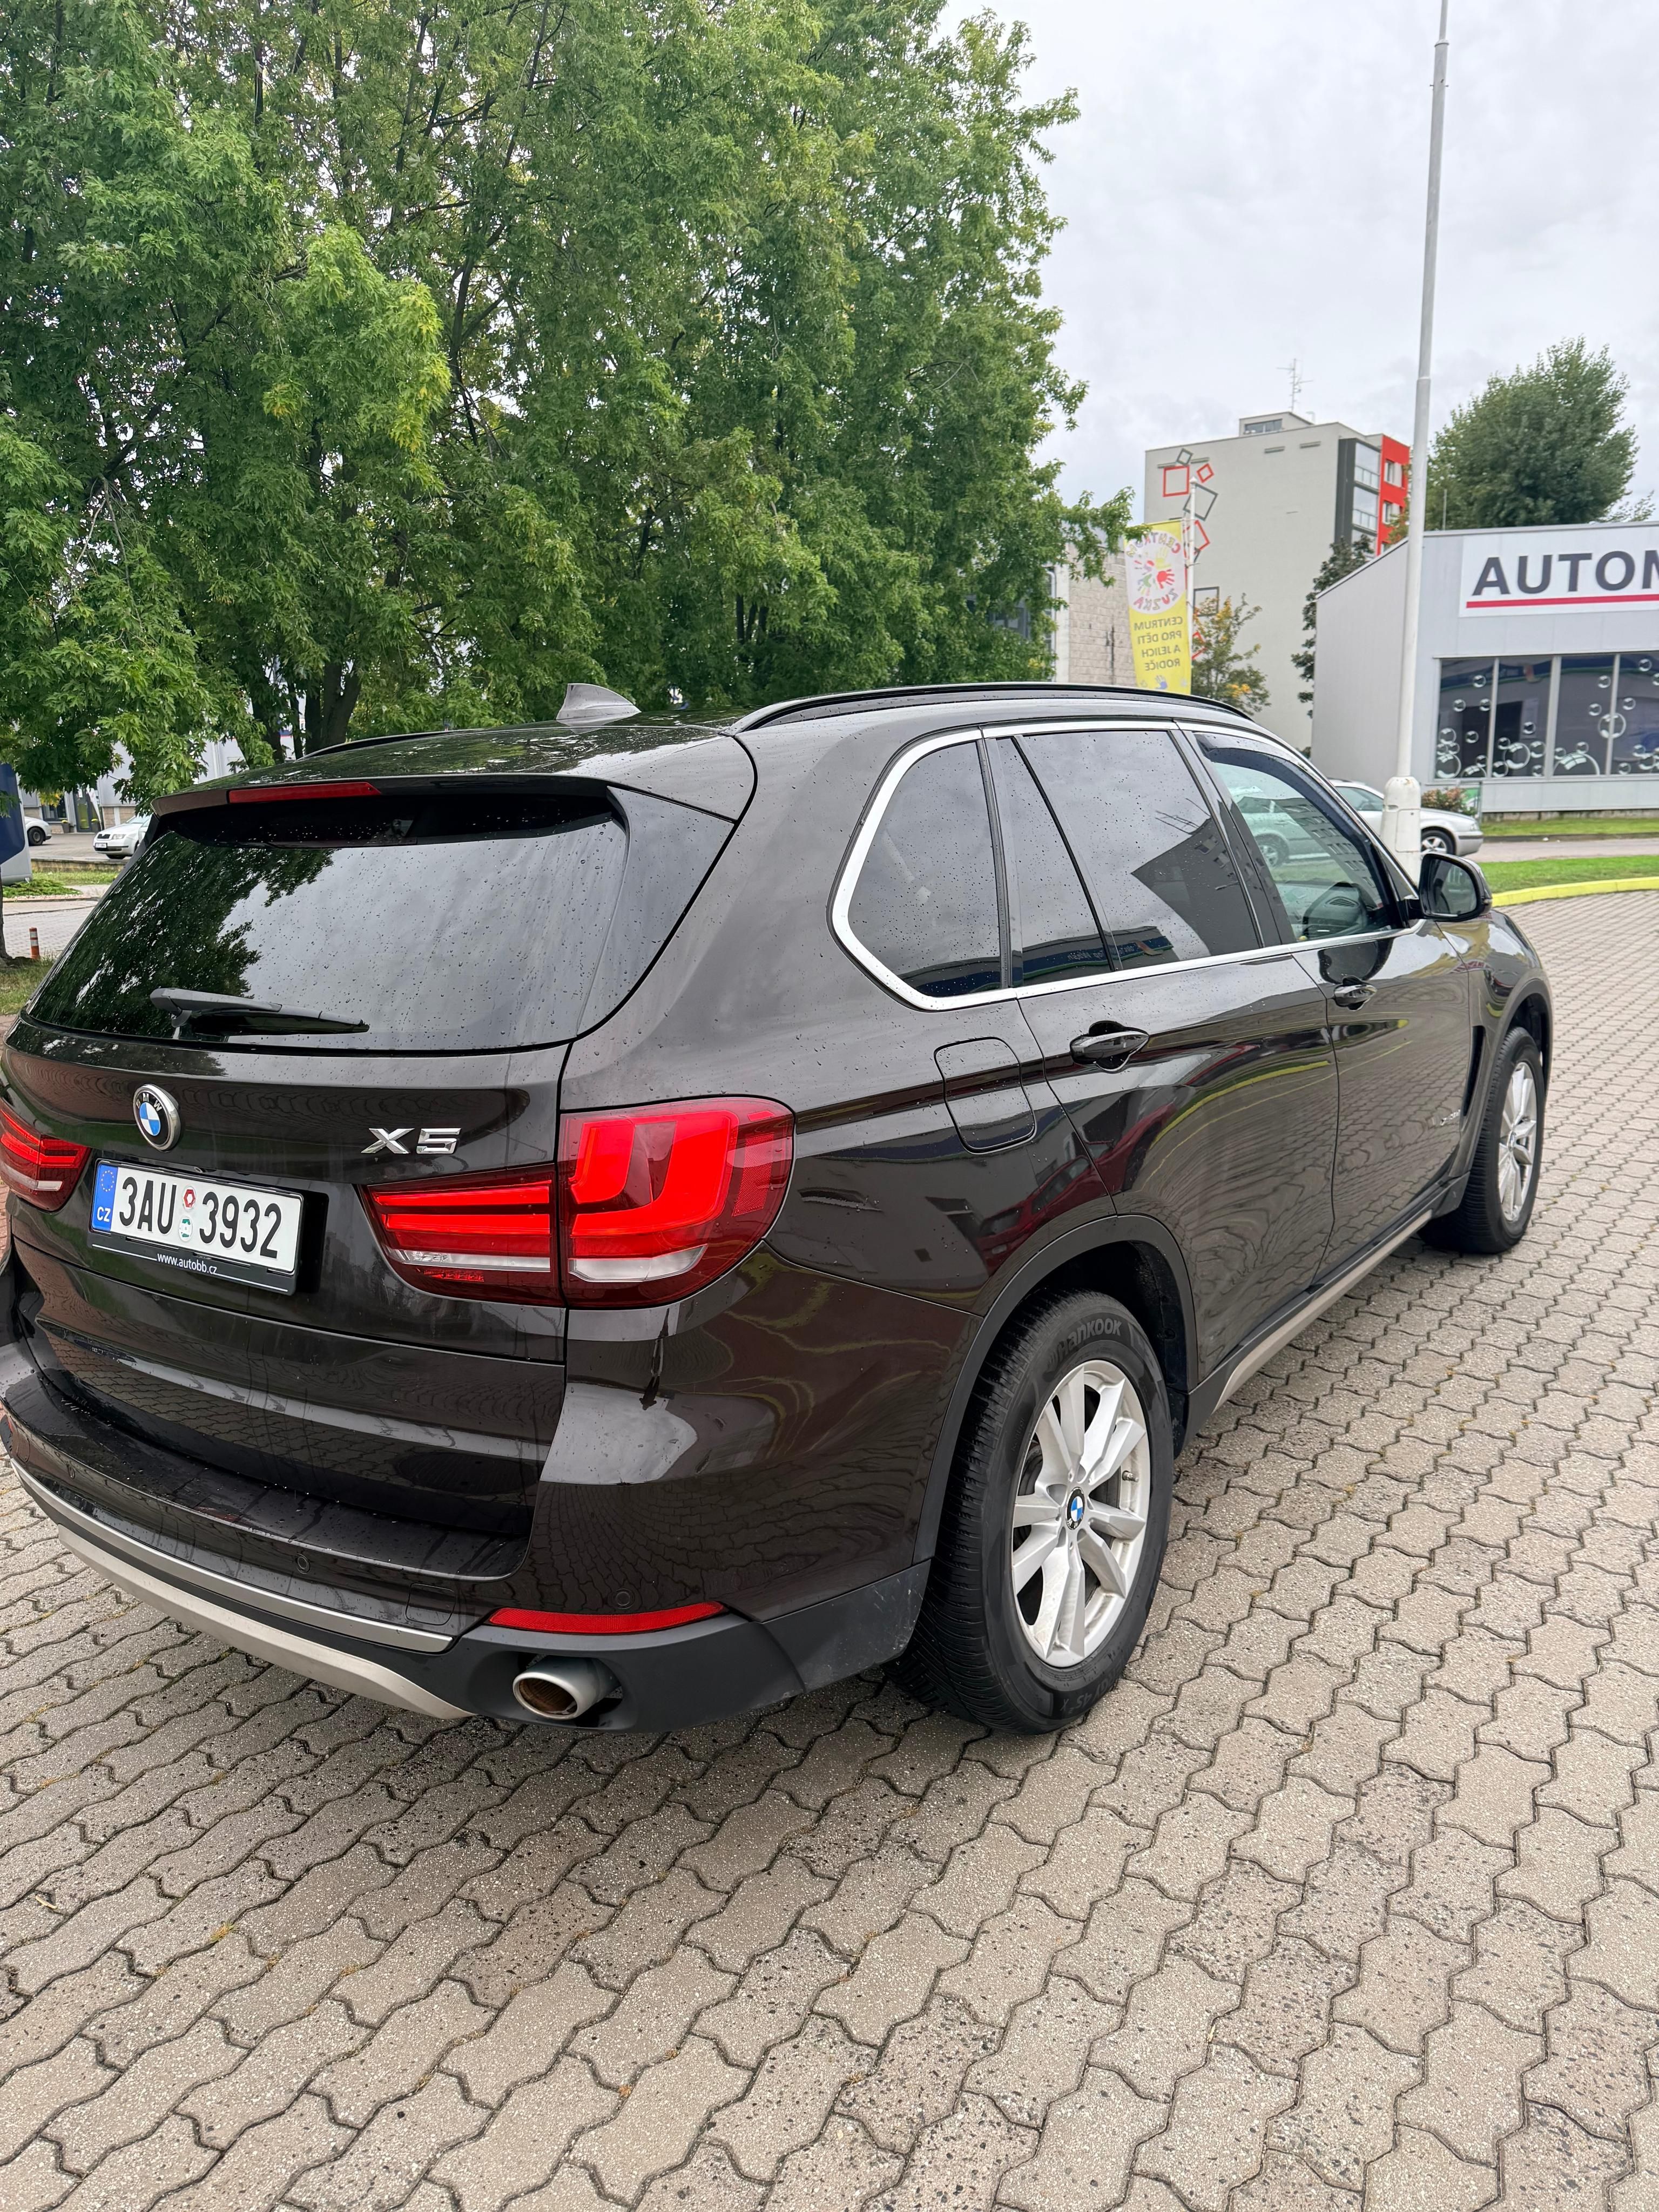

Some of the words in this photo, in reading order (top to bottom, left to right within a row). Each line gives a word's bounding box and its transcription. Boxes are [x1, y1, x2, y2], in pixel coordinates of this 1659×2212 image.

[136, 1092, 163, 1111] BMW
[361, 1128, 462, 1154] X5
[97, 1206, 111, 1222] CZ
[119, 1177, 177, 1235] 3AU
[199, 1191, 281, 1259] 3932
[157, 1253, 217, 1274] www.autobb.cz
